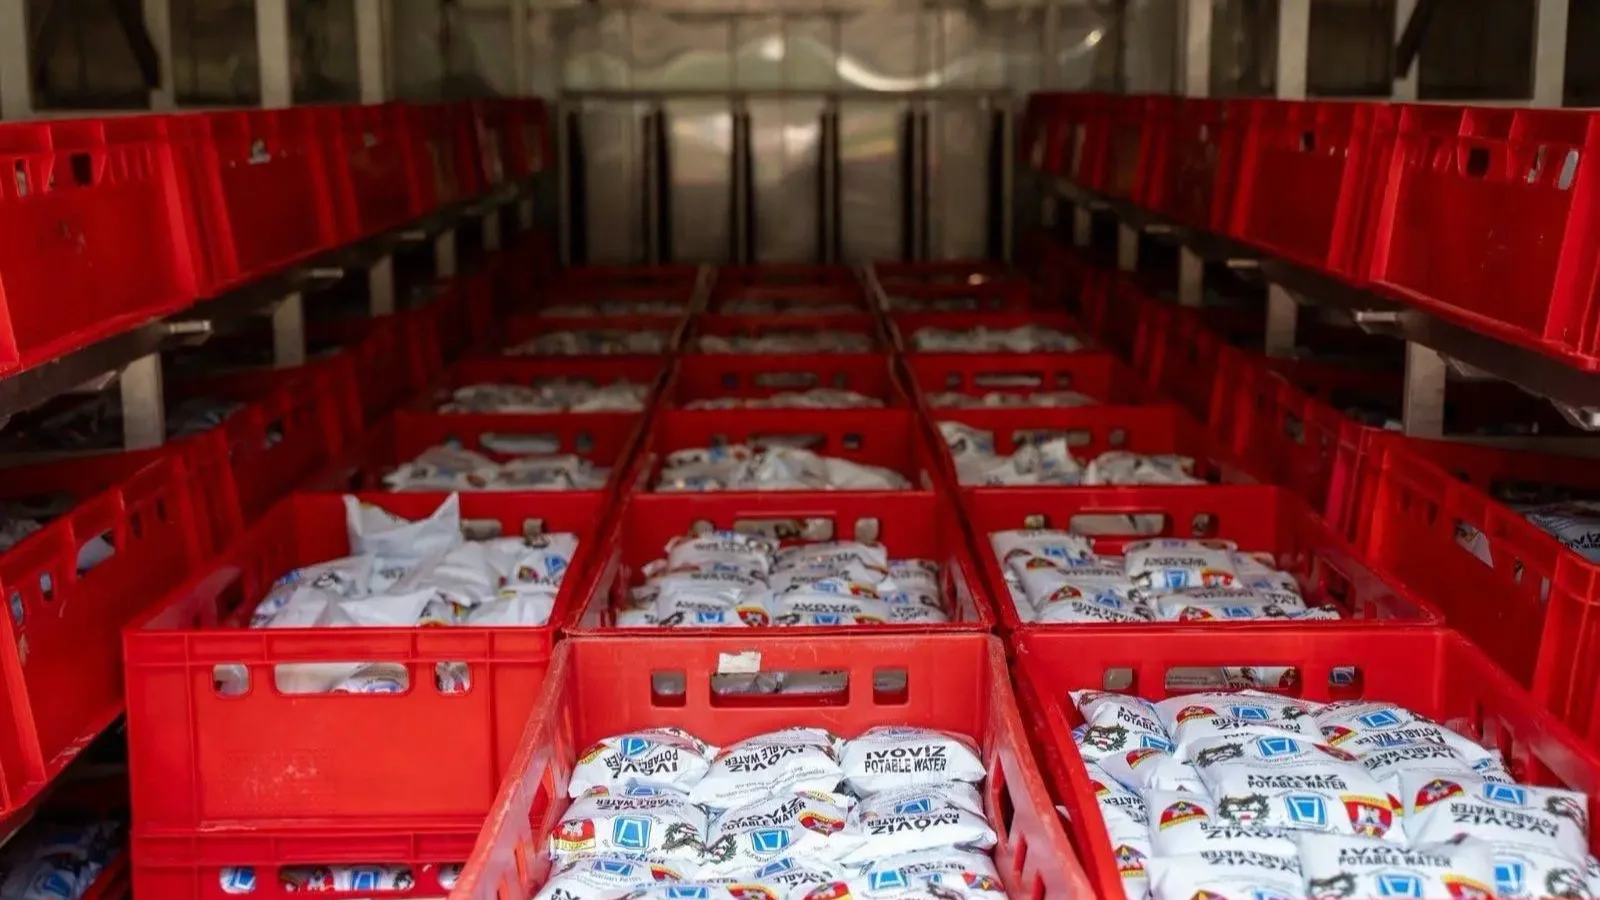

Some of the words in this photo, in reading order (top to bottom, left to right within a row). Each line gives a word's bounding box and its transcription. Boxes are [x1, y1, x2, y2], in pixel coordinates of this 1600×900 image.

[1116, 711, 1161, 735] POTABLE
[1400, 727, 1441, 743] POTABLE
[725, 752, 760, 767] WATER
[865, 758, 912, 774] POTABLE
[914, 757, 947, 772] WATER
[1247, 779, 1301, 789] POTABLE
[1303, 780, 1348, 791] WATER
[771, 801, 807, 826] WATER
[1450, 802, 1495, 819] WATER
[866, 815, 905, 827] WATER
[1338, 855, 1400, 867] POTABLE
[1403, 856, 1453, 869] WATER
